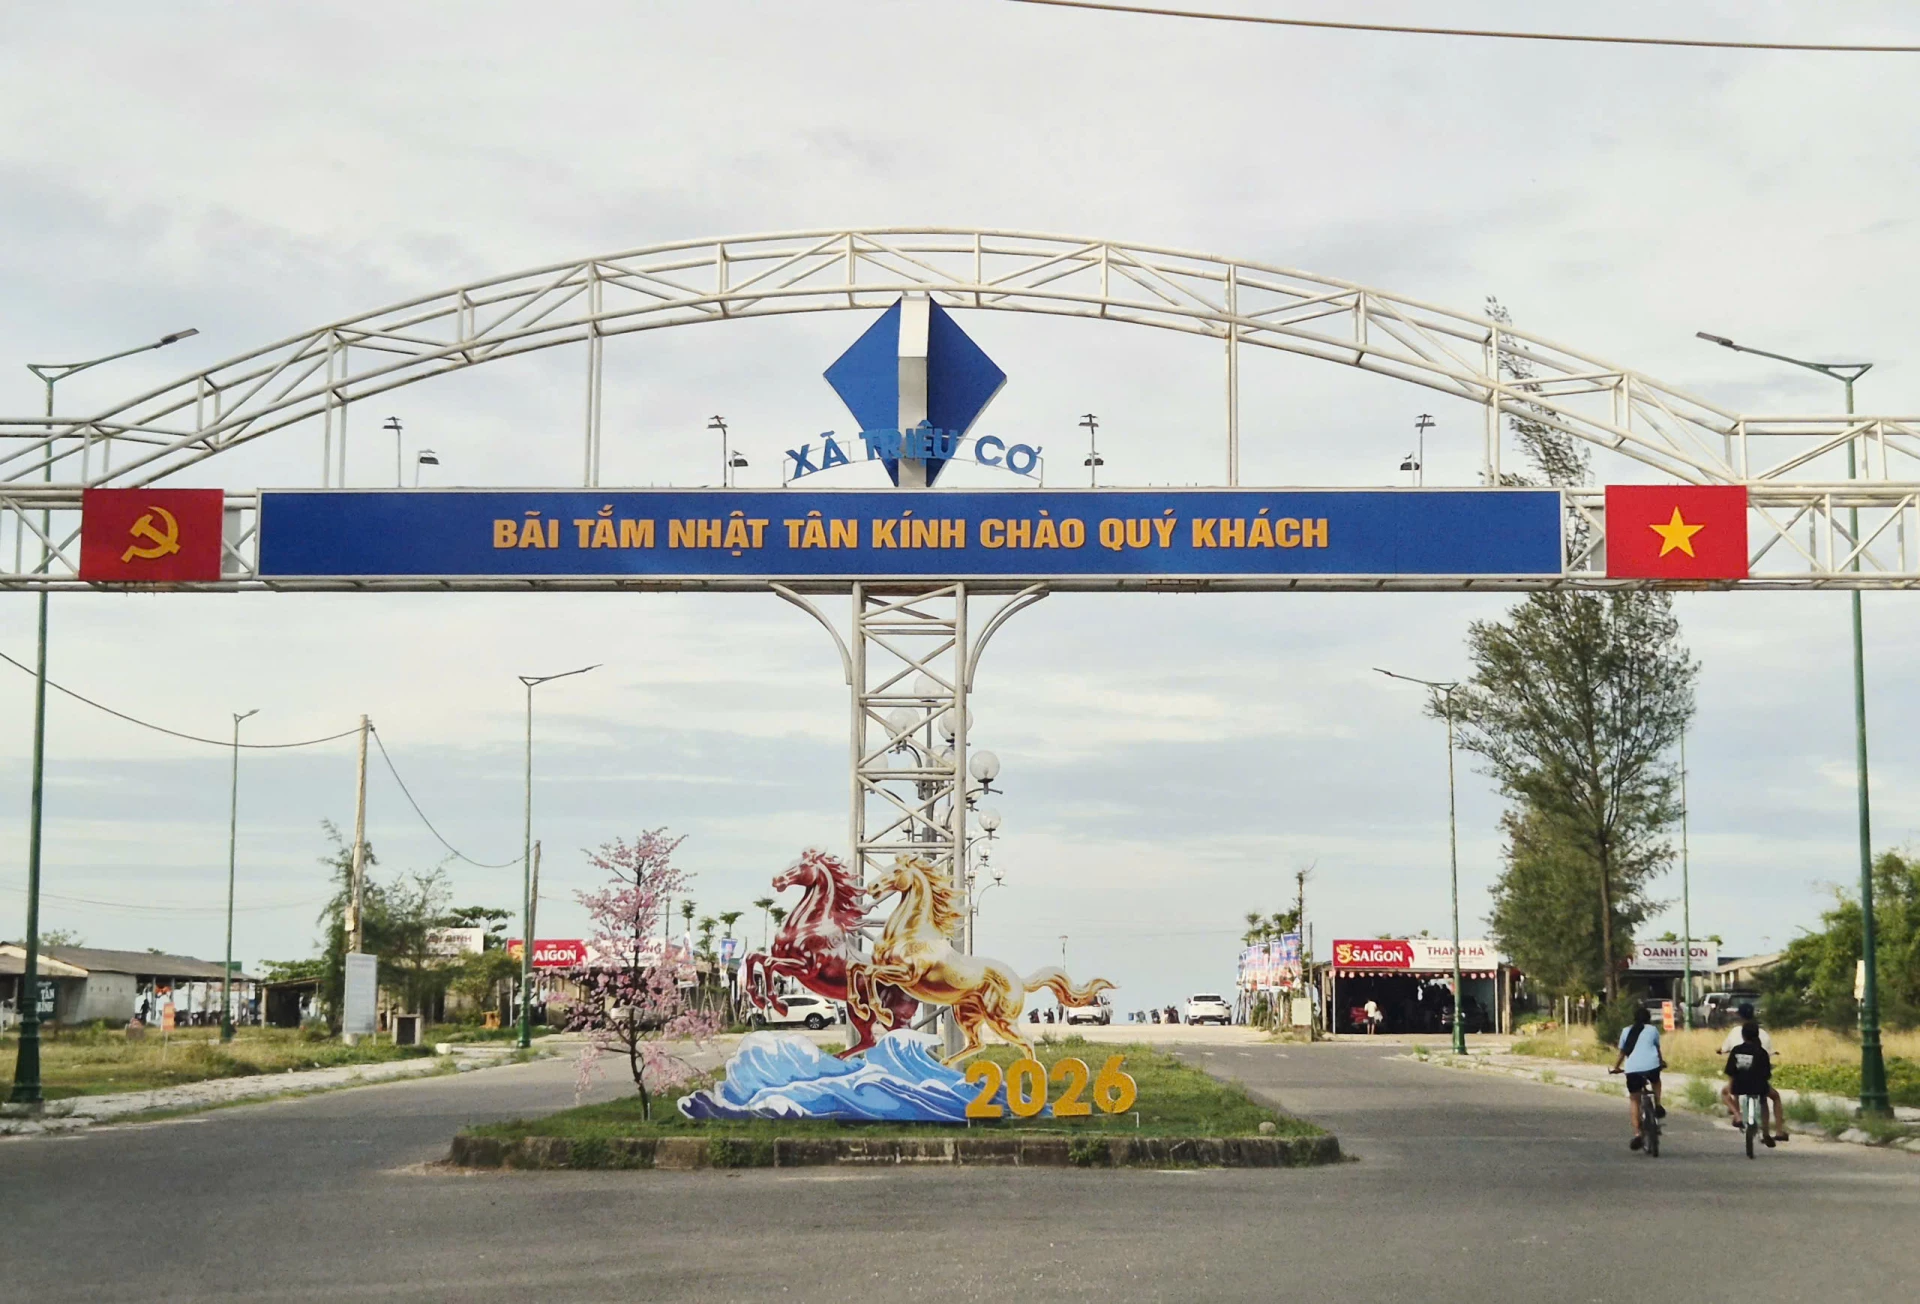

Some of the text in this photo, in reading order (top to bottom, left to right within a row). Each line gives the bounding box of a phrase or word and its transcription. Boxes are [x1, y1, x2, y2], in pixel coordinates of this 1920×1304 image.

[785, 419, 1043, 480] XÃ TRIỆU CƠ
[492, 504, 1329, 557] BÃI TẮM NHẬT TÂN KÍNH CHÀO QUÝ KHÁCH
[532, 949, 577, 961] AIGON
[1352, 949, 1404, 962] SAIGON
[1643, 947, 1678, 957] OANH
[965, 1054, 1138, 1118] 2026
